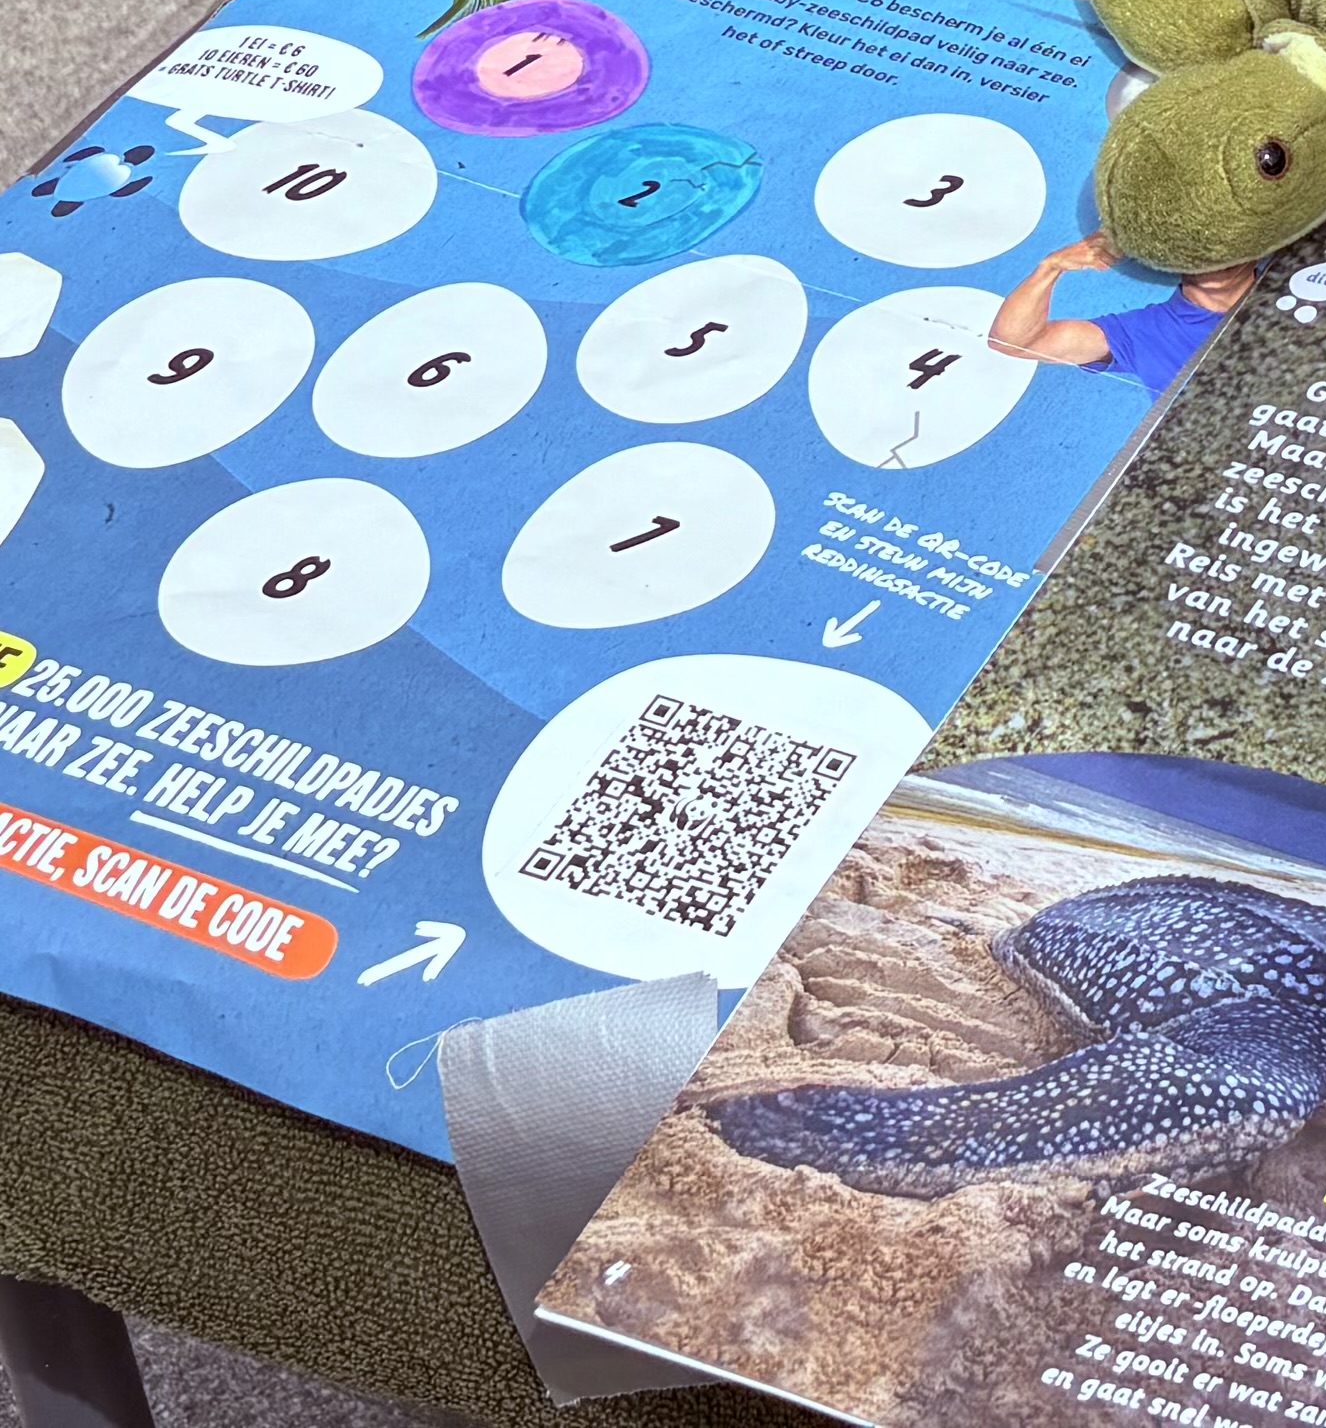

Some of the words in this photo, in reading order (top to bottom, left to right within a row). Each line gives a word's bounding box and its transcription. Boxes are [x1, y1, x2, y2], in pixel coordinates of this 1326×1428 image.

[217, 49, 272, 70] EIEREN
[721, 25, 759, 45] het
[759, 39, 786, 52] of
[782, 46, 848, 71] streep
[850, 60, 899, 86] door.
[886, 0, 985, 37] bescherm
[982, 26, 1006, 43] je
[1007, 37, 1029, 49] al
[1029, 41, 1067, 62] één
[1069, 55, 1092, 68] ei
[215, 66, 270, 88] TURTLE
[270, 76, 336, 100] T-SHIRT!
[503, 54, 543, 77] 1
[798, 22, 851, 46] Kleur
[851, 37, 889, 58] het
[889, 50, 911, 64] ei
[911, 54, 948, 75] dan
[950, 65, 973, 84] in,
[980, 75, 1050, 104] versier
[937, 39, 989, 64] veilig
[990, 55, 1039, 77] naar
[1038, 70, 1078, 88] zee.
[262, 164, 347, 201] 10
[617, 180, 661, 208] 2
[902, 174, 965, 208] 3
[664, 321, 729, 358] 5
[146, 347, 215, 385] 9
[406, 351, 472, 388] 6
[906, 348, 963, 390] 4
[1214, 487, 1249, 514] is
[1257, 497, 1321, 534] het
[819, 521, 856, 542] EN
[854, 536, 928, 571] STEUN
[927, 567, 993, 600] MIJN
[823, 492, 885, 524] SCAN
[883, 516, 919, 539] DE
[917, 532, 1030, 588] QR-CODE
[261, 555, 332, 599] 8
[801, 543, 971, 620] REDDINGSACTIE
[1164, 542, 1242, 582] Reis
[1251, 572, 1326, 608] met
[1167, 583, 1232, 617] van
[1243, 599, 1308, 639] het
[1166, 620, 1258, 659] naar
[1266, 646, 1313, 678] de
[11, 658, 155, 729] 25.000
[136, 699, 460, 837] ZEESCHILDPADJES
[62, 735, 153, 795] ZEE.
[143, 763, 254, 825] HELP
[237, 798, 300, 845] JE
[281, 812, 400, 878] MEE?
[73, 845, 173, 911] SCAN
[159, 876, 218, 929] DE
[208, 894, 304, 961] CODE
[1100, 1195, 1171, 1232] Maar
[1174, 1221, 1247, 1253] soms
[604, 1259, 632, 1286] 4
[1063, 1261, 1097, 1284] en
[1101, 1266, 1157, 1301] legt
[1160, 1288, 1191, 1308] er
[1099, 1229, 1145, 1261] het
[1147, 1249, 1238, 1286] strand
[1239, 1275, 1278, 1301] op.
[1114, 1310, 1188, 1343] eitjes
[1191, 1328, 1225, 1358] in.
[1233, 1342, 1308, 1382] Soms
[1040, 1366, 1074, 1390] en
[1077, 1378, 1146, 1409] gaat
[1075, 1334, 1111, 1361] Ze
[1112, 1350, 1189, 1384] gooit
[1192, 1372, 1223, 1393] er
[1228, 1381, 1283, 1413] wat
